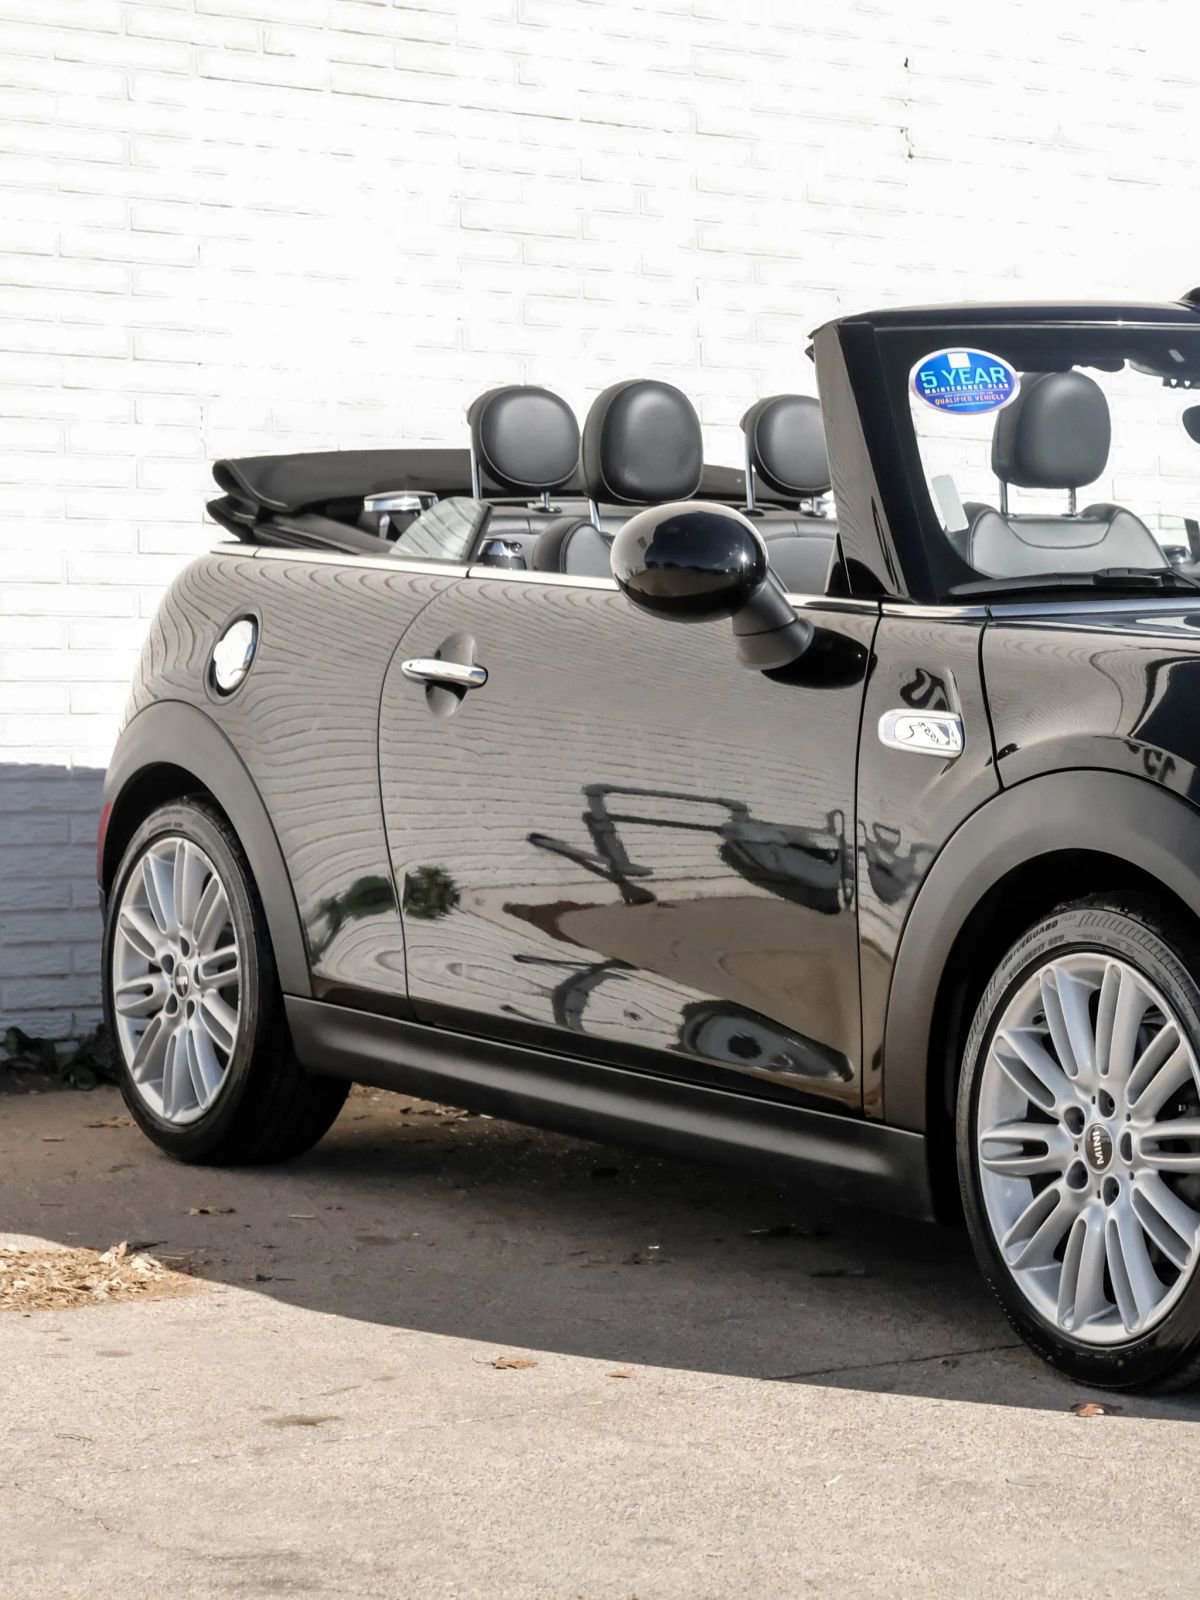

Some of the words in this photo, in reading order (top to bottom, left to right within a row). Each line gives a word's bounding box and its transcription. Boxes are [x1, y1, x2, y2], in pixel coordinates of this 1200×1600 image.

[920, 370, 938, 388] 5
[941, 366, 1008, 386] YEAR
[924, 383, 984, 395] MAINTENANCE
[989, 382, 1010, 390] PLAN
[934, 395, 973, 406] QUALIFIED
[975, 393, 1005, 402] VEHICLE
[1002, 919, 1059, 970] DRIVEGUARD
[1092, 1130, 1105, 1166] MINI
